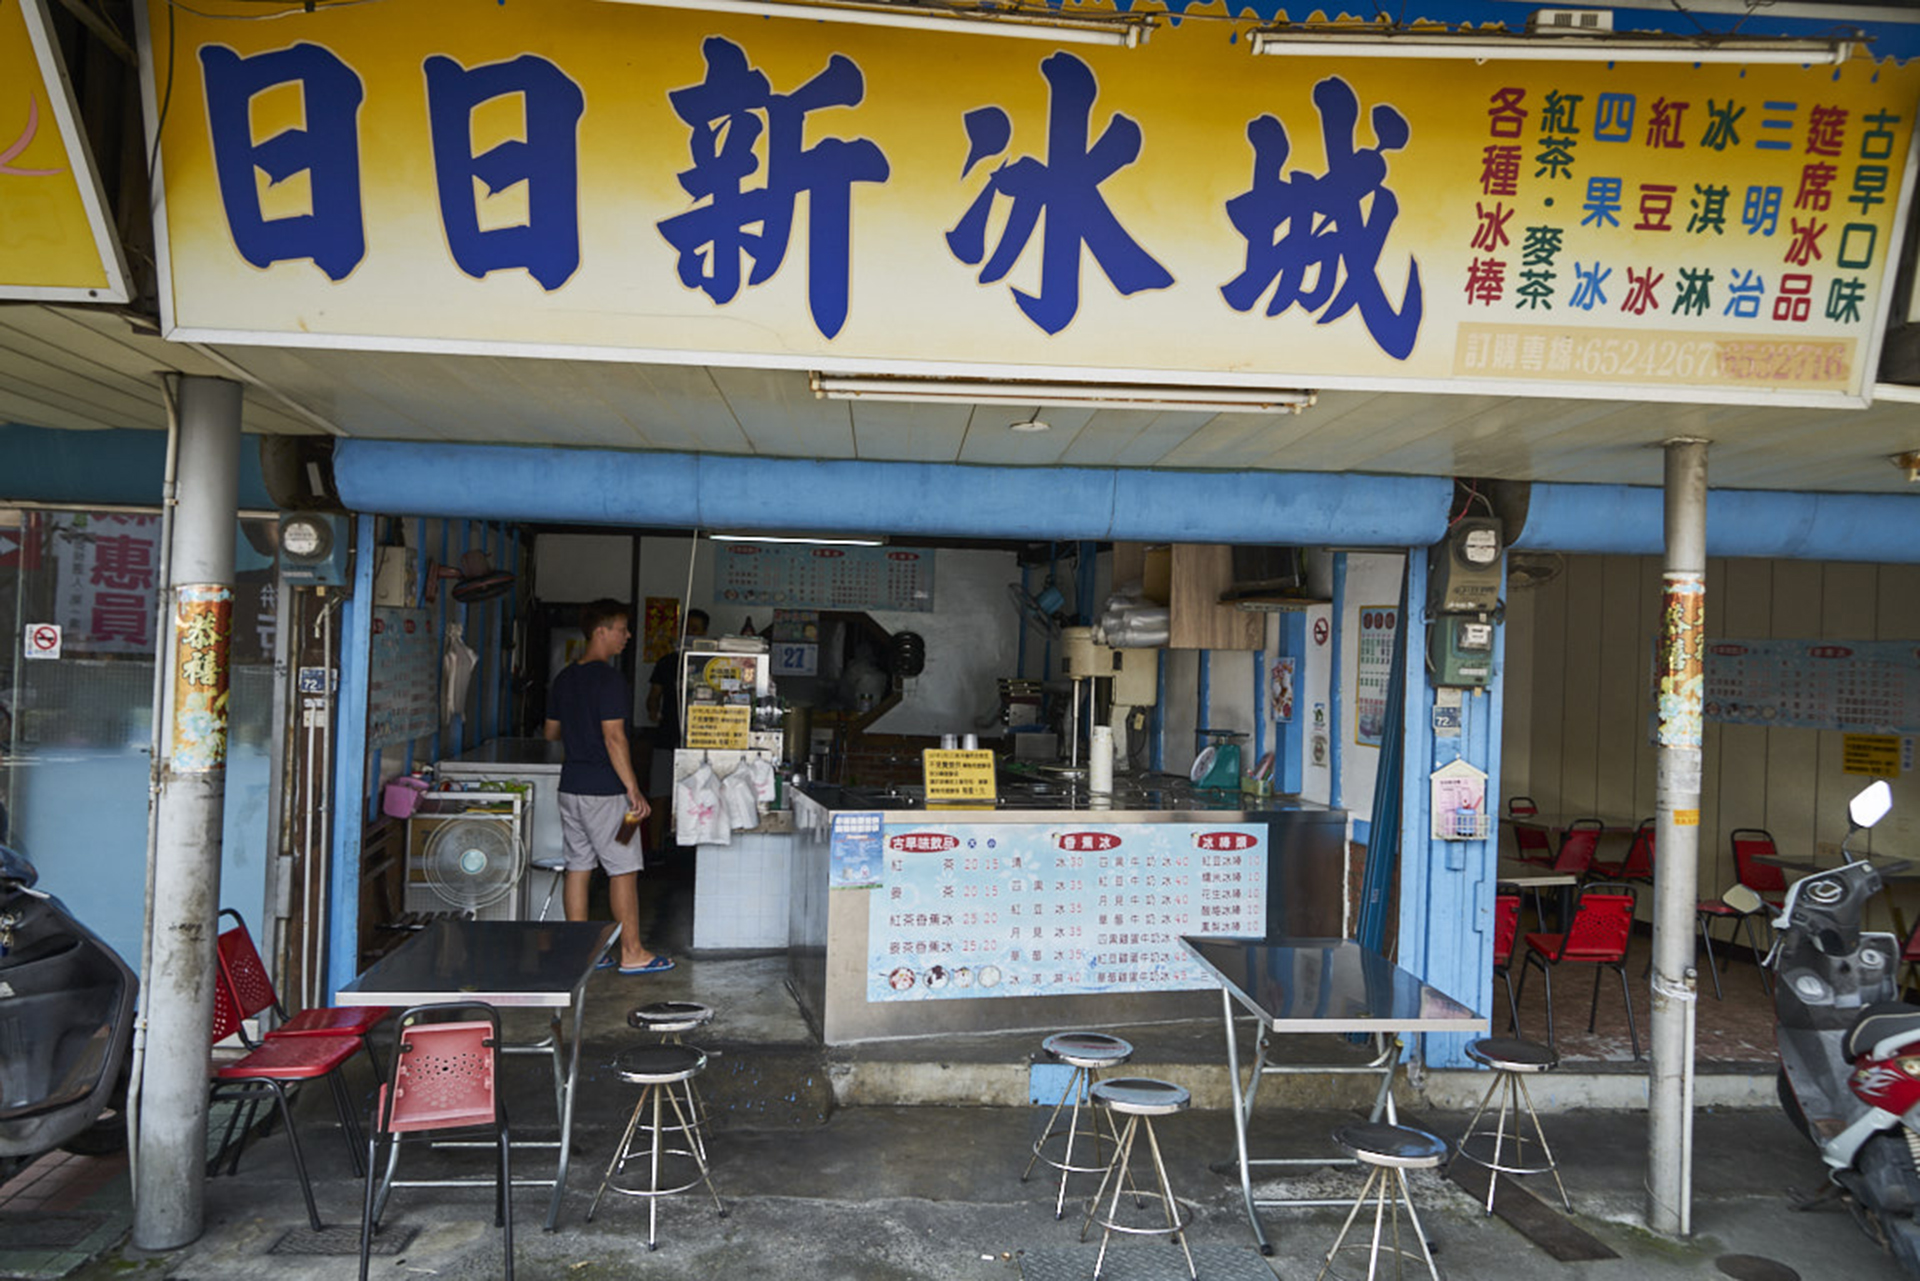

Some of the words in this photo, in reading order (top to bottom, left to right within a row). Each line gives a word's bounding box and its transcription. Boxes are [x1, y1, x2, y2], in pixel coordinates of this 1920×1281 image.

[199, 36, 1422, 359] 日日新冰城
[1464, 86, 1529, 306] 各種冰棒
[1568, 91, 1637, 310] 四果冰
[1620, 96, 1690, 316] 紅豆冰
[1672, 98, 1746, 316] 冰淇淋
[1723, 100, 1797, 319] 三明治
[1772, 103, 1850, 322] 筵席冰品
[1825, 108, 1901, 324] 古早口味
[304, 679, 318, 690] 72
[784, 647, 805, 668] 27
[1436, 716, 1450, 726] 72
[892, 836, 956, 850] 古早味飲品
[964, 858, 978, 870] 20
[985, 858, 999, 870] 15
[964, 885, 978, 897] 20
[985, 885, 998, 897] 15
